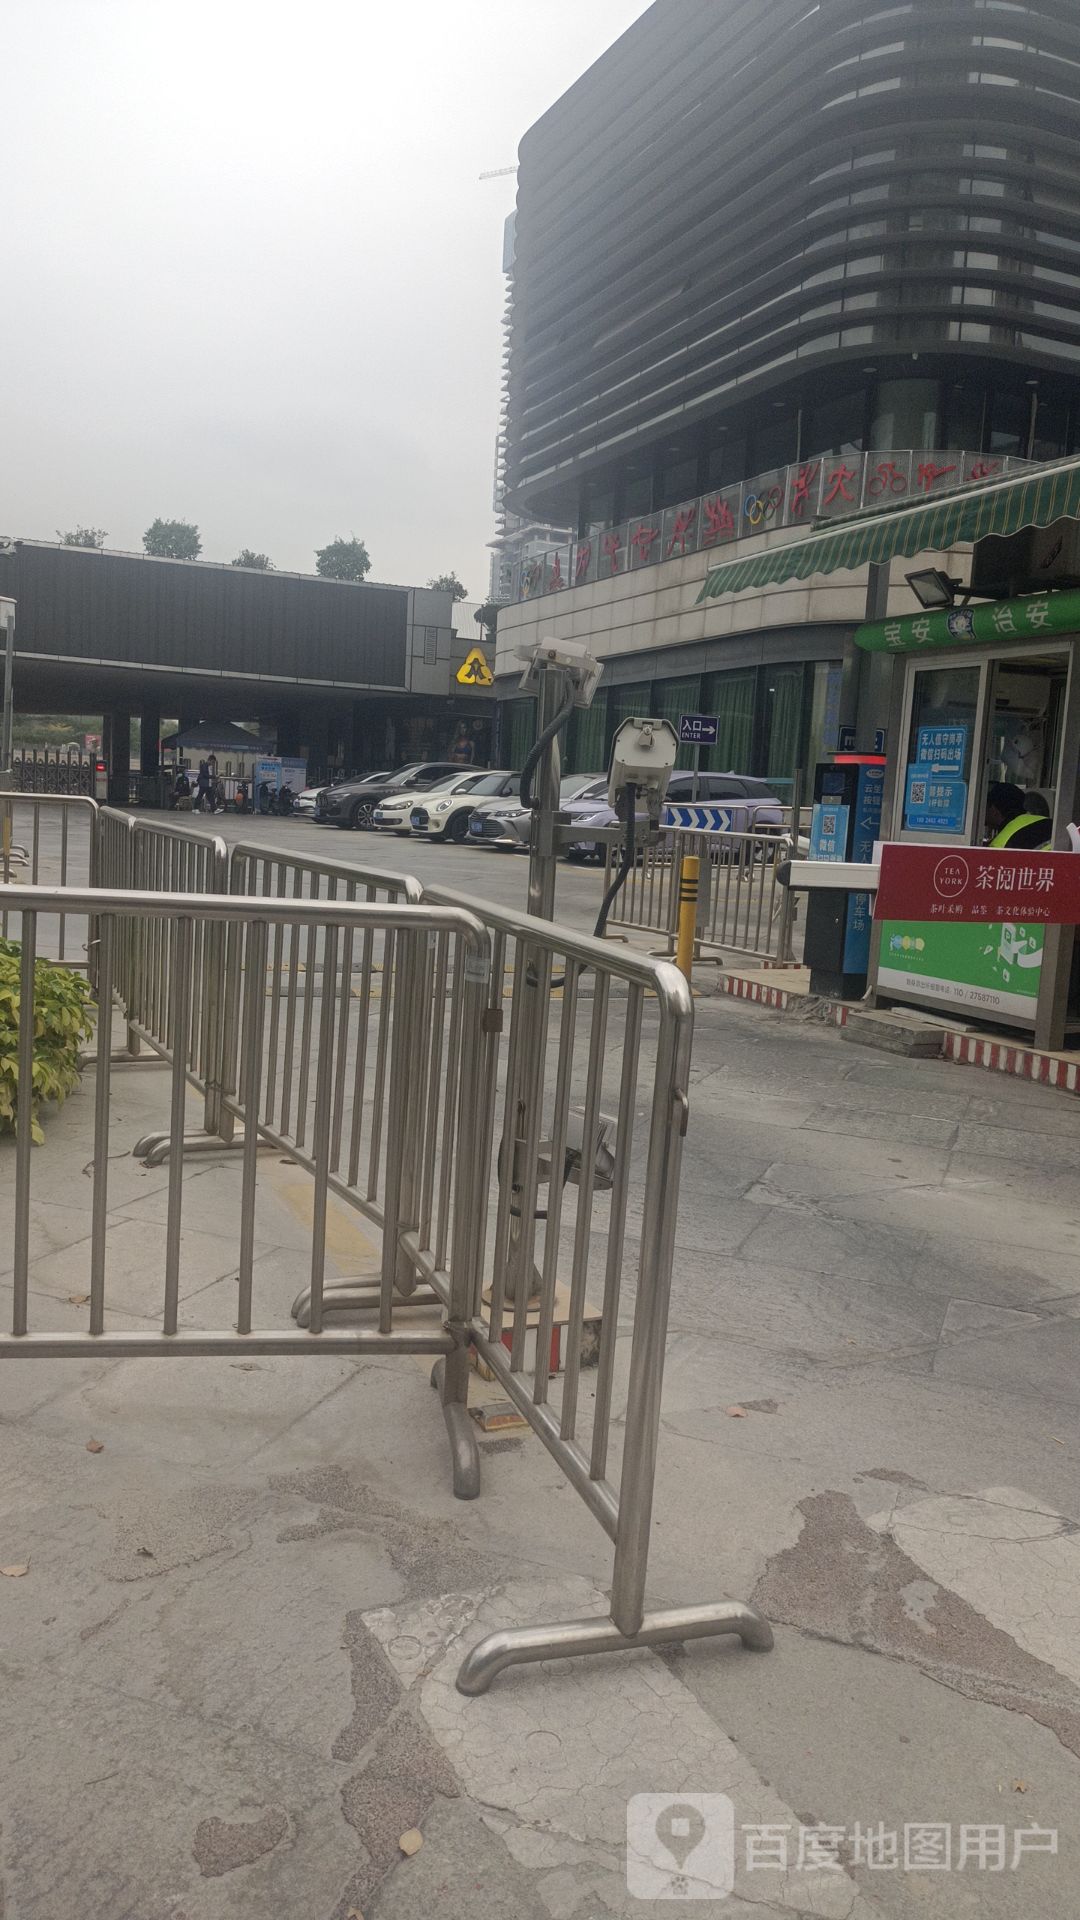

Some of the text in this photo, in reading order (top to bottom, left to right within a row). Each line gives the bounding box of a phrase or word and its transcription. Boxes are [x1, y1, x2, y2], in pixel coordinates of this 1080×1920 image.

[884, 618, 934, 647] 宝安
[992, 600, 1052, 633] 治安
[682, 720, 702, 731] 入口
[921, 733, 963, 746] 无人值守岗亭
[920, 748, 962, 761] 微信扫码出场
[819, 838, 835, 853] 微信
[944, 867, 961, 875] TEA
[939, 877, 963, 886] YORK
[975, 865, 1055, 893] 茶阅世界
[953, 987, 964, 997] 110
